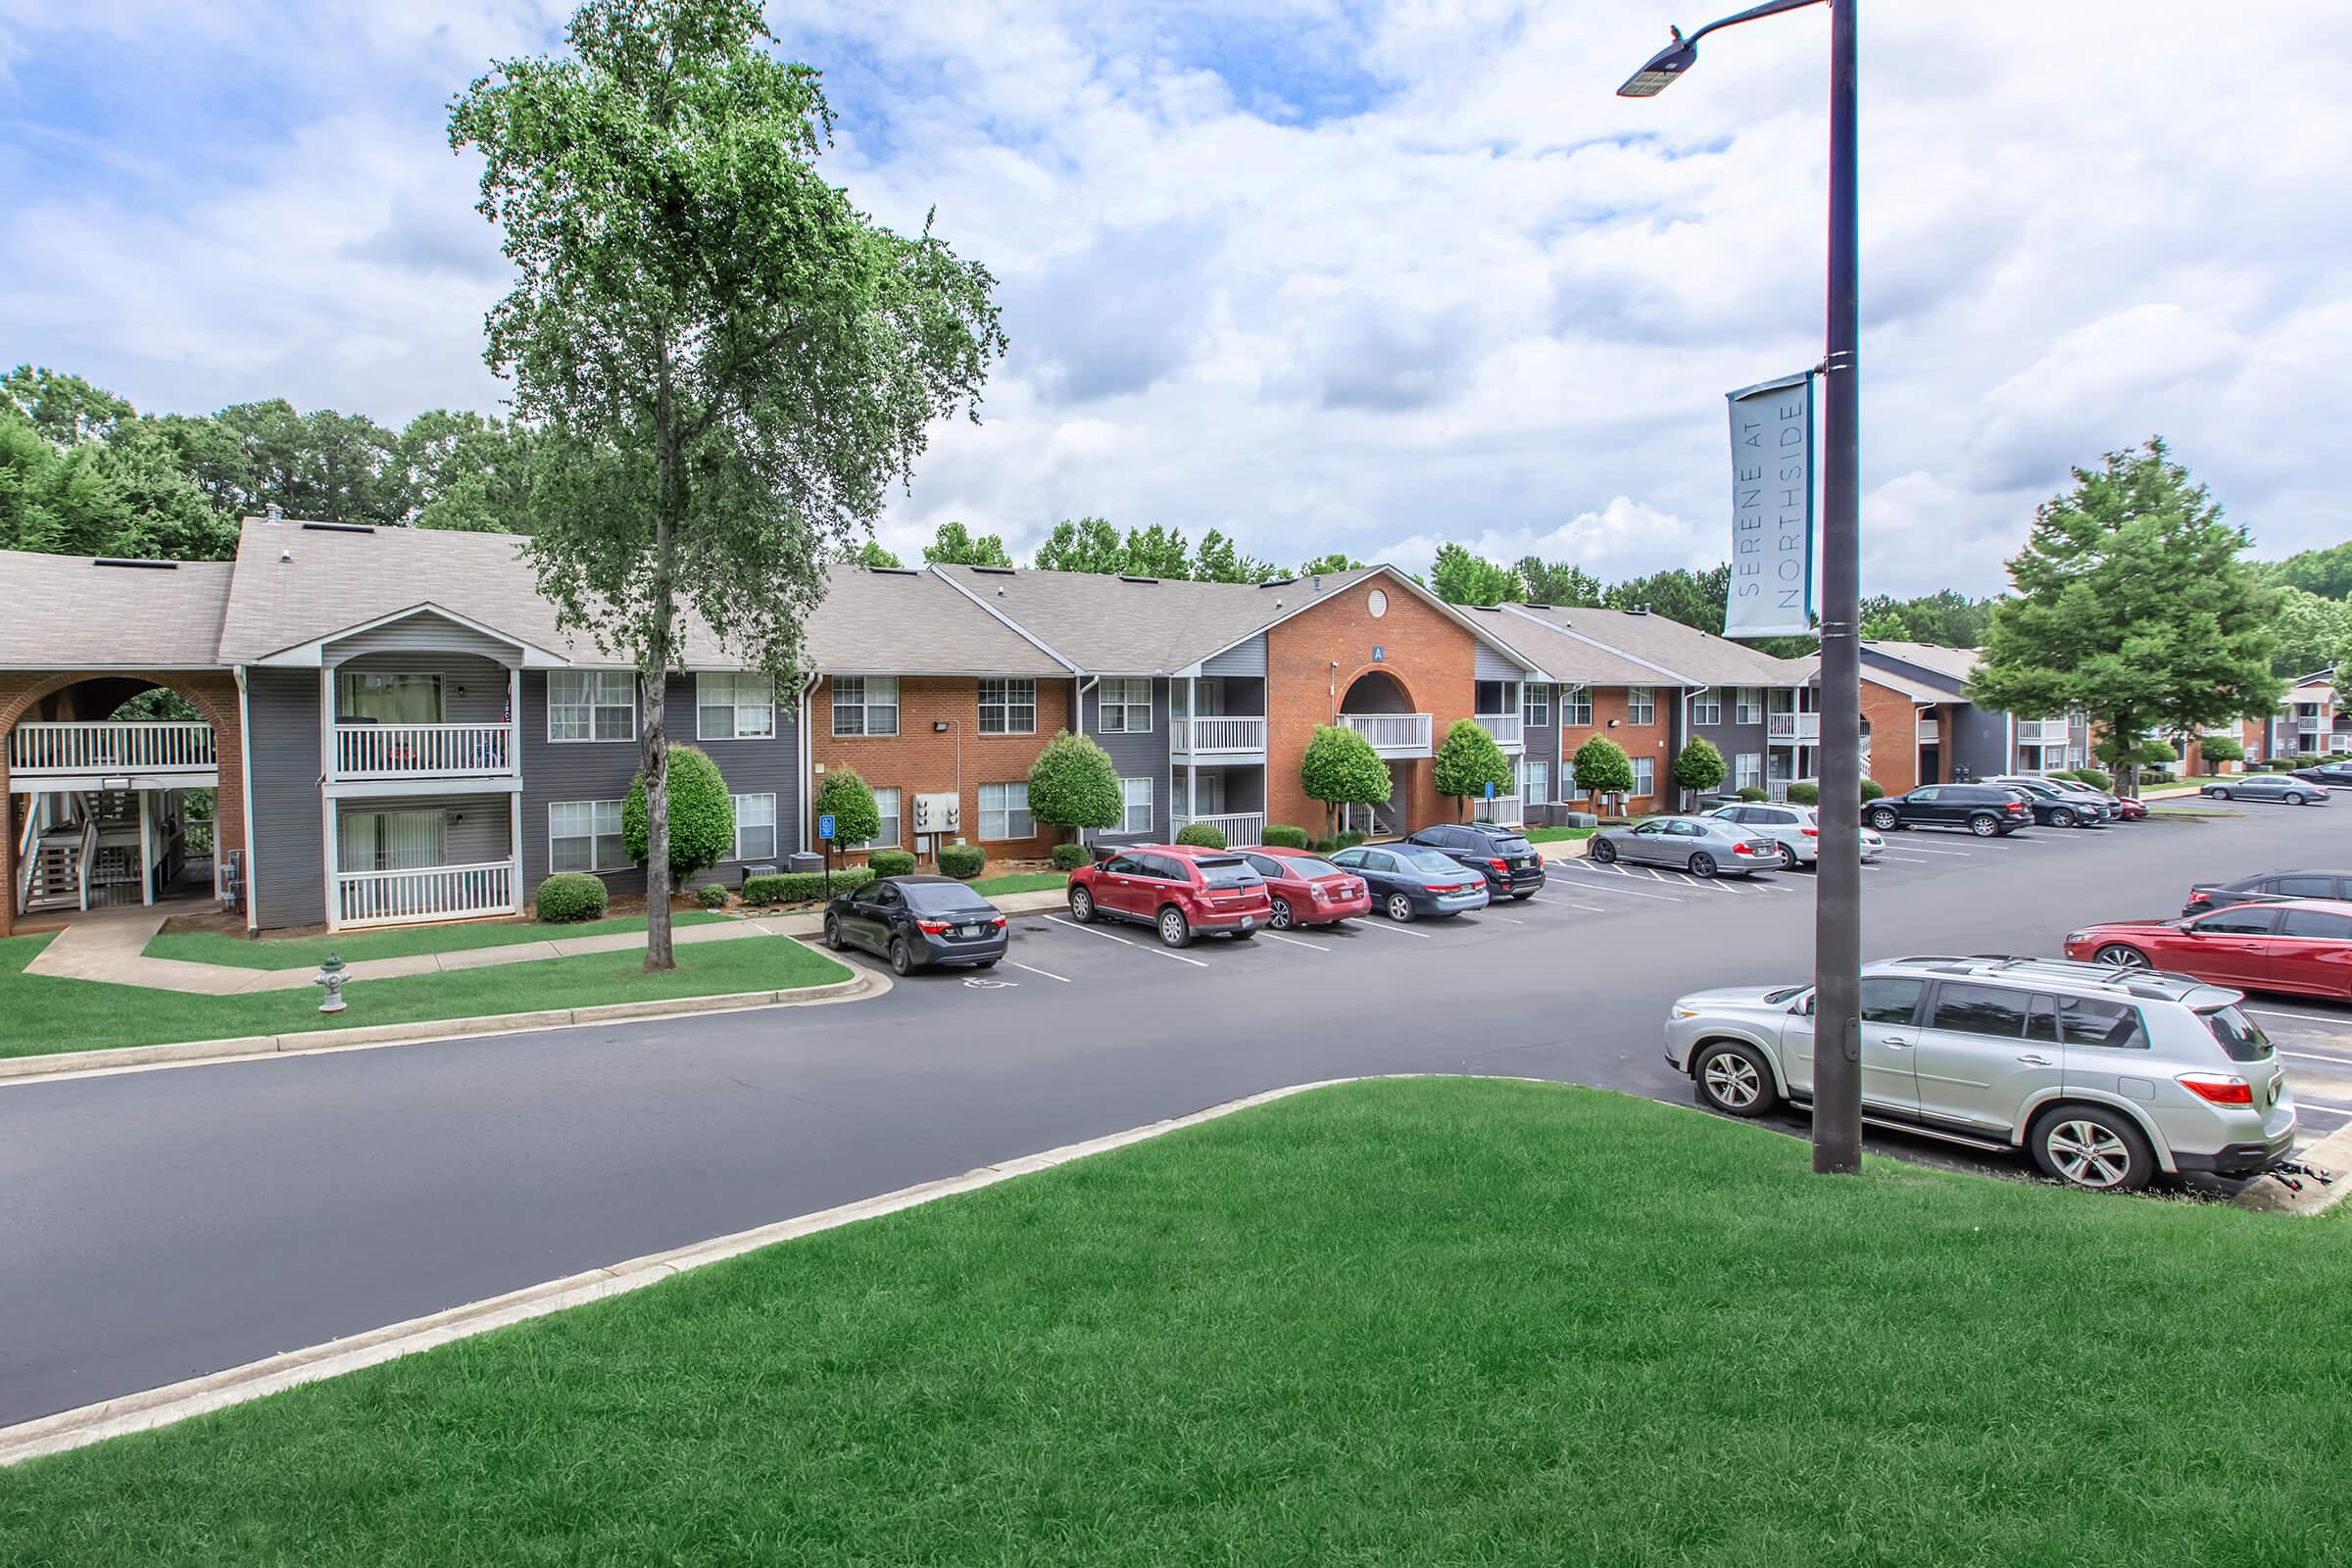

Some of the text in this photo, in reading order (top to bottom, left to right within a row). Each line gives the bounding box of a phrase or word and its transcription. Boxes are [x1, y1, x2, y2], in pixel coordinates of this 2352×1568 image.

[1739, 422, 1762, 597] SERENE AT
[1778, 401, 1802, 609] NORTHSIDE
[1374, 647, 1382, 660] A
